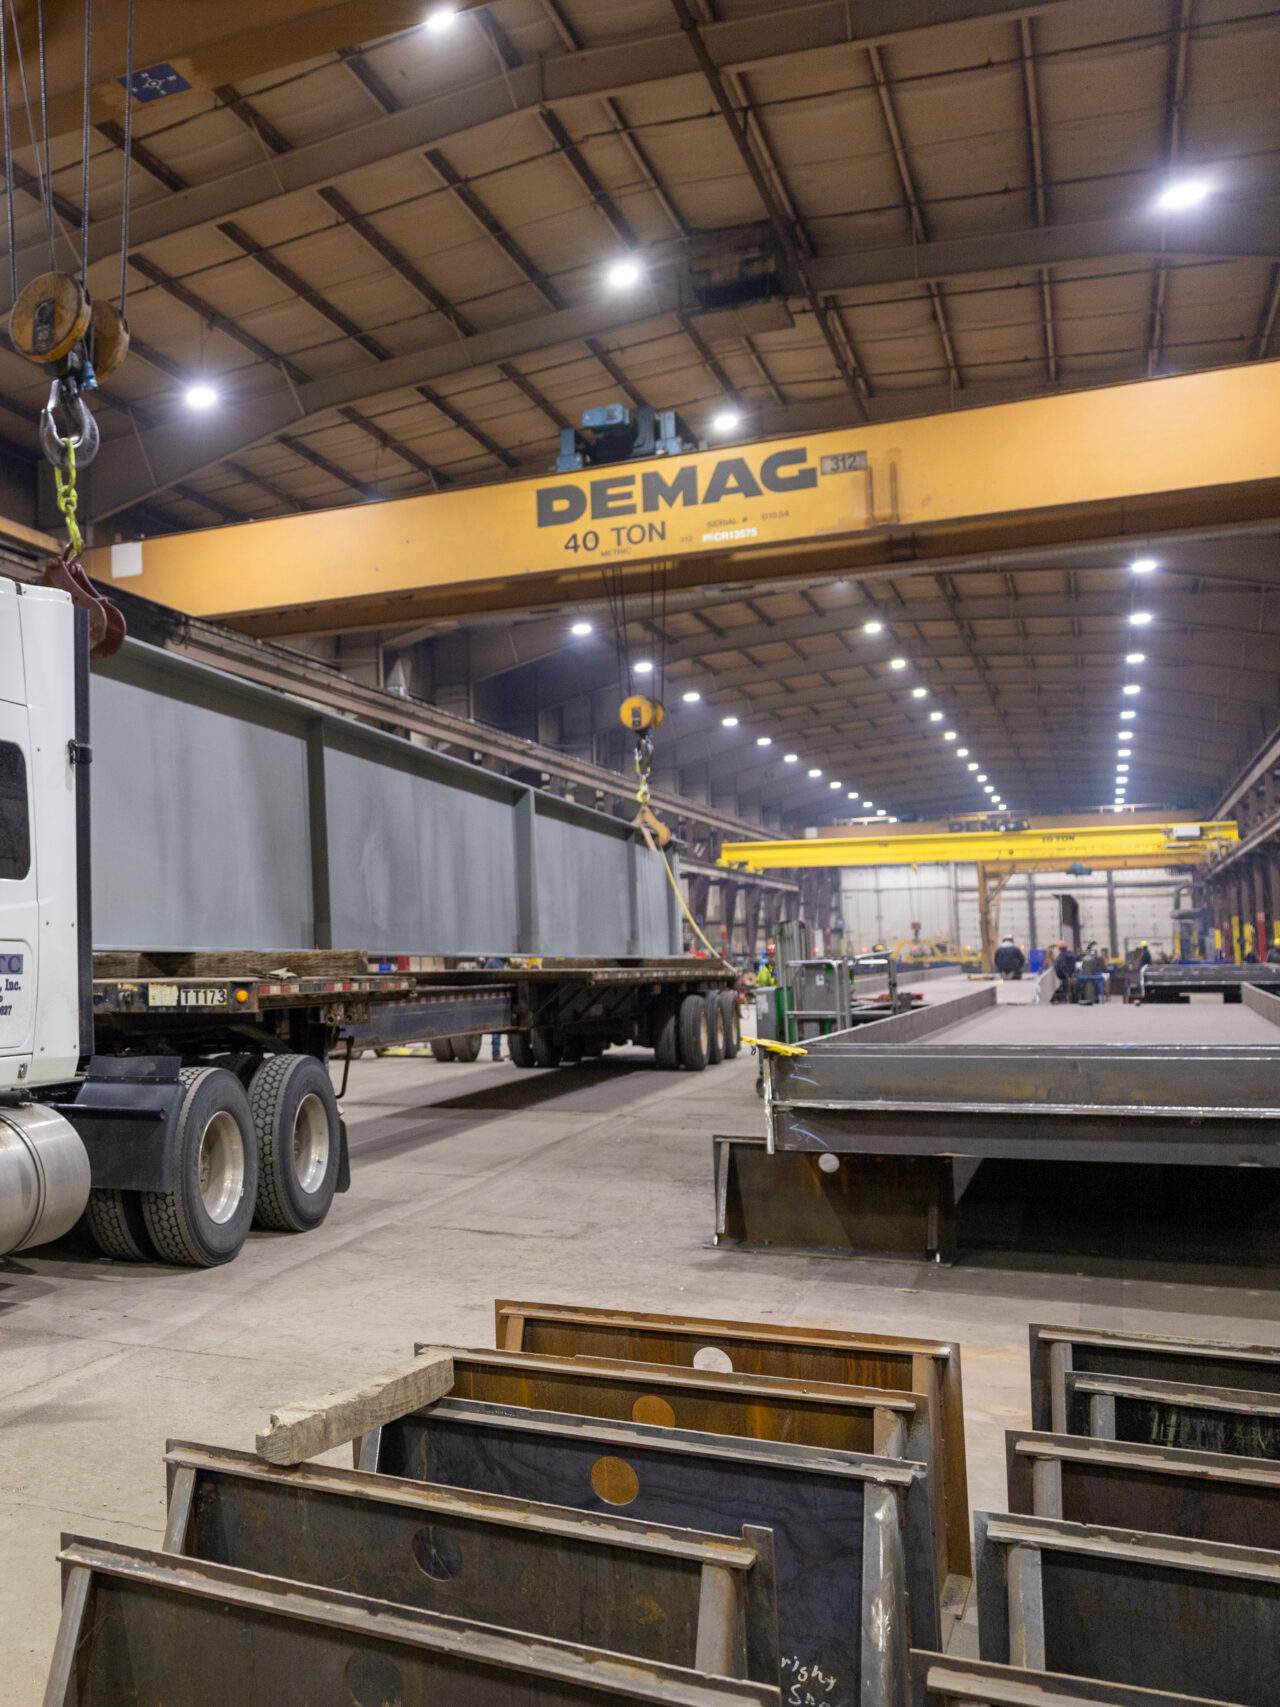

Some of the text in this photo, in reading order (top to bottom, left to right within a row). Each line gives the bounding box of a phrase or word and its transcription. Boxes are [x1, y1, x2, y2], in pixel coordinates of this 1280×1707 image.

[831, 454, 858, 472] 312
[536, 447, 818, 528] DEMAG
[564, 521, 666, 553] 40 TON
[5, 978, 21, 991] Inc.
[182, 989, 226, 1005] TT173
